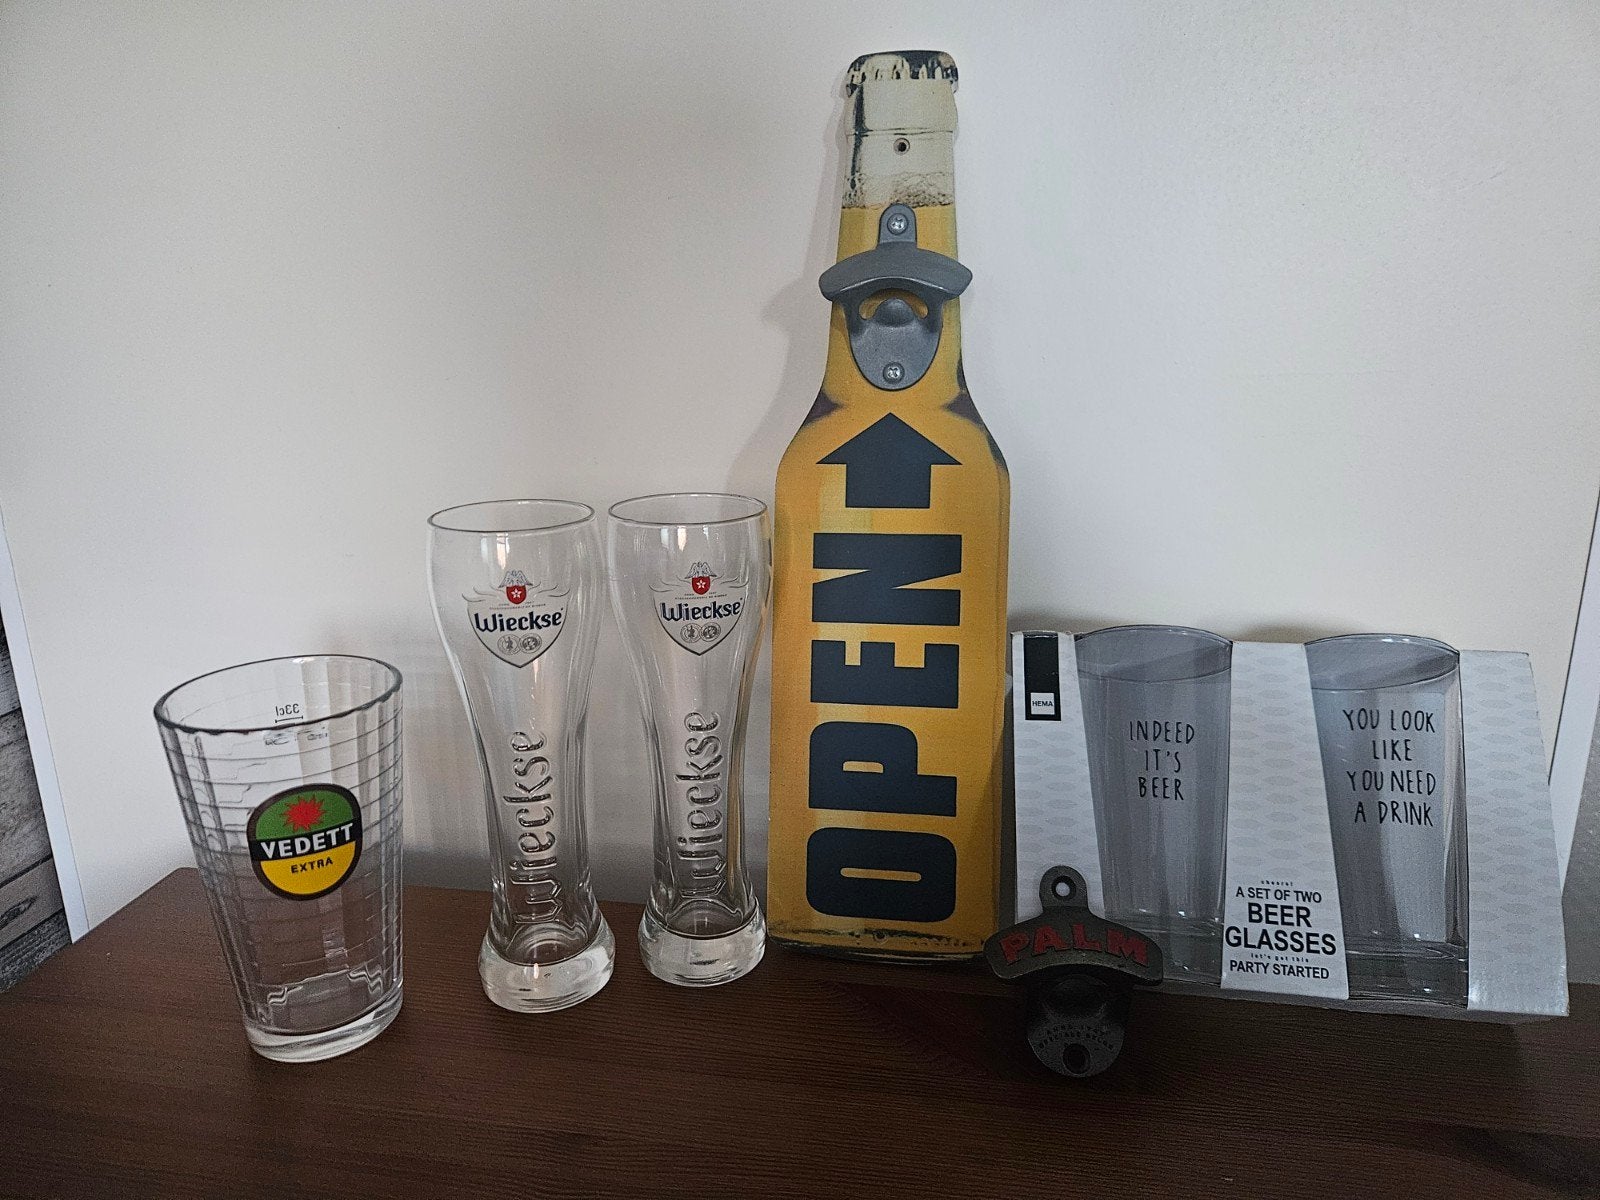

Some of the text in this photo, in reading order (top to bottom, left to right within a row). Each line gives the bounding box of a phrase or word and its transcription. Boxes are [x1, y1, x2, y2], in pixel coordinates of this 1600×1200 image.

[474, 610, 563, 633] Wieckse
[661, 600, 742, 622] Wieckse
[806, 532, 962, 923] OPEN
[1129, 720, 1195, 744] INDEED
[1342, 708, 1435, 733] YOU LOOK
[1145, 749, 1181, 773] IT'S
[1372, 739, 1412, 761] LIKE
[1138, 777, 1184, 801] BEER
[1346, 770, 1436, 795] YOU NEED
[674, 712, 727, 898] Wieckse
[1354, 800, 1433, 827] A DRINK
[503, 731, 562, 924] Wieckse
[261, 823, 353, 859] VEDETT
[291, 857, 333, 874] EXTRA
[1235, 886, 1322, 903] A SET OF TWO
[1248, 902, 1312, 928] BEER
[1000, 923, 1149, 967] PALM
[1225, 926, 1337, 956] GLASSES
[1229, 960, 1330, 979] PARTY STARTED
